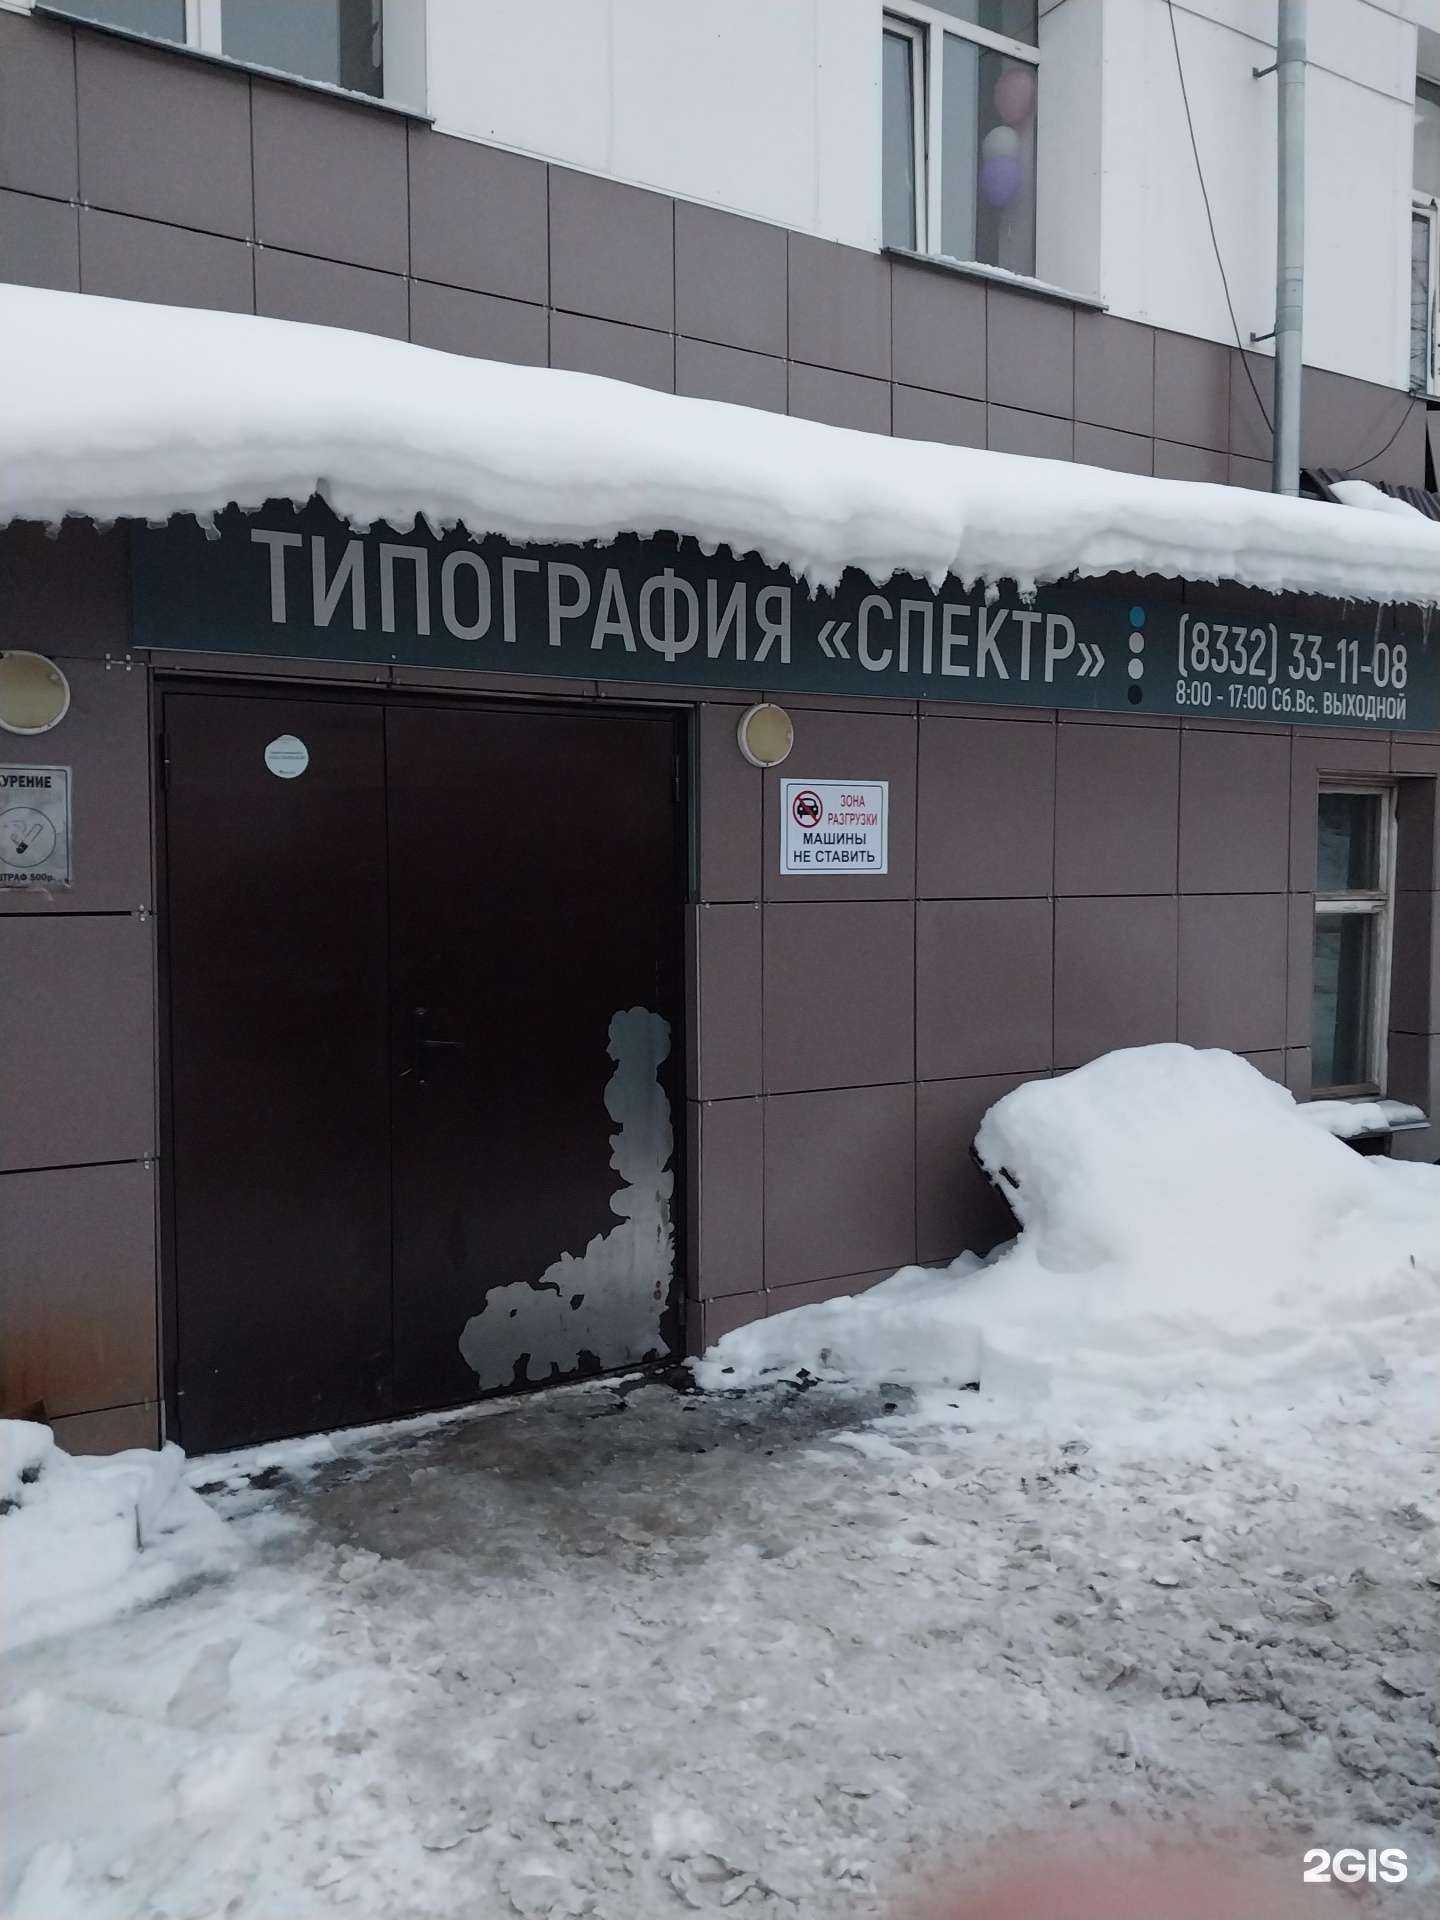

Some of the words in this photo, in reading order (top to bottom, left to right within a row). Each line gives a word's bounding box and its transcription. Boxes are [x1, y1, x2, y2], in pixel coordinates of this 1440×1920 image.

[251, 528, 792, 664] ТИПОГРАФИЯ
[816, 594, 1106, 683] «СПЕКТР»
[1178, 613, 1278, 685] (8332)
[1288, 632, 1408, 689] 33-11-08
[1176, 679, 1212, 706] 8:00
[1228, 684, 1267, 710] 17:00
[1323, 690, 1407, 722] ВЫХОДНОЙ
[840, 794, 866, 808] ЗОНА
[827, 812, 878, 827] РАЗГРУЗКИ
[803, 832, 866, 845] МАШИНЫ
[793, 850, 811, 863] НЕ
[815, 850, 875, 864] СТАВИТЬ
